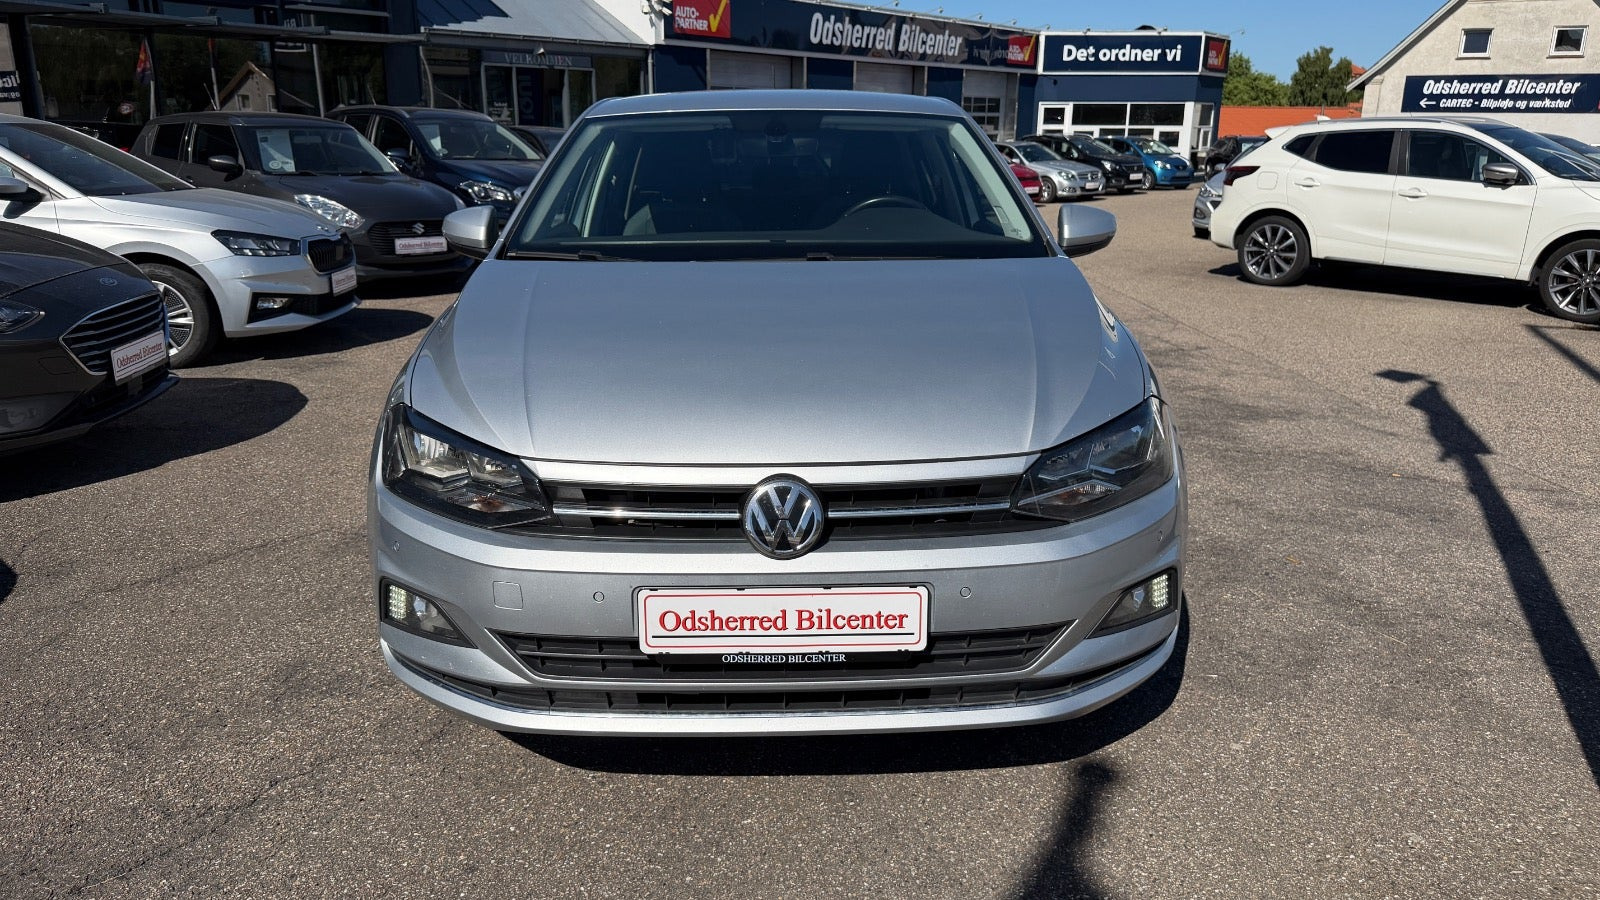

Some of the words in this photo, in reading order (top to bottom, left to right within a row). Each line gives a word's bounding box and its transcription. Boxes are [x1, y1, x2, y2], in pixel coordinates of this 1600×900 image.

[675, 6, 700, 18] AUTO-
[675, 17, 708, 31] PARTNER
[809, 12, 896, 50] Odsherred
[898, 23, 963, 57] Bilcenter
[504, 52, 573, 66] VELKOMMEN
[1062, 44, 1096, 62] Det
[1098, 44, 1162, 62] ordner
[1164, 44, 1182, 62] vi
[1422, 79, 1504, 96] Odsherred
[1504, 79, 1581, 95] Bilcenter
[1439, 98, 1473, 108] CARTEC
[1515, 100, 1527, 109] og
[1528, 98, 1572, 108] værksted
[116, 348, 143, 369] Odsherred
[142, 342, 163, 357] Bilcenter
[658, 609, 788, 632] Odsherred
[795, 608, 909, 631] Bilcenter
[721, 654, 787, 663] ODSHERRED
[787, 653, 847, 663] BILCENTER
